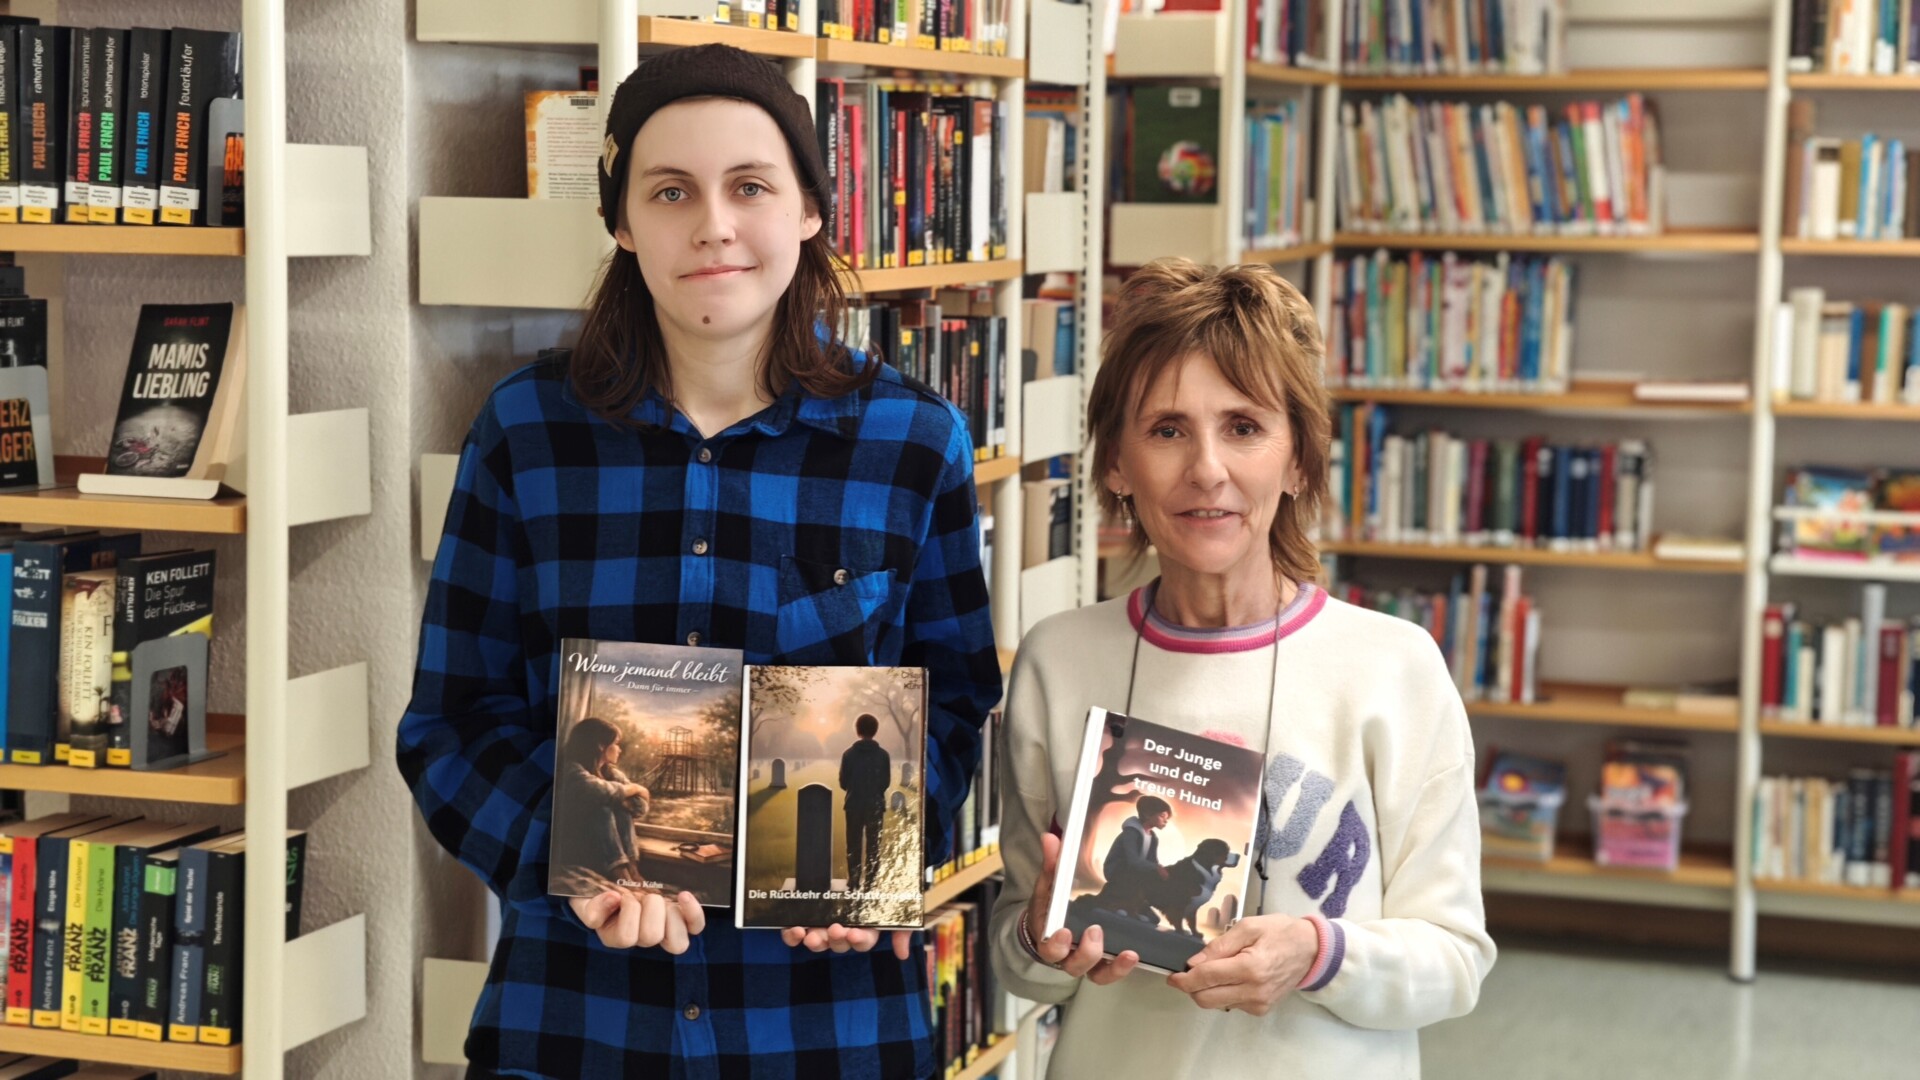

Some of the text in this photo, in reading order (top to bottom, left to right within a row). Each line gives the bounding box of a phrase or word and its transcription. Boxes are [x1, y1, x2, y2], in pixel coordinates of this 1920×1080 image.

[33, 38, 44, 93] rattenfänger
[80, 36, 90, 107] spurensammler
[104, 36, 116, 107] schattenschläfer
[140, 52, 151, 98] totenspieler
[179, 44, 193, 106] feuerläufer
[32, 102, 46, 169] PAUL FINCH
[78, 112, 92, 148] FINCH
[100, 112, 114, 148] FINCH
[136, 112, 150, 145] FINCH
[175, 112, 191, 148] FINCH
[77, 152, 90, 181] PAUL
[99, 152, 112, 181] PAUL
[135, 148, 148, 175] PAUL
[173, 152, 188, 182] PAUL
[148, 342, 210, 369] MAMIS
[132, 372, 211, 399] LIEBLING
[0, 399, 31, 428] ERZ
[146, 563, 210, 585] KEN FOLLETT
[126, 593, 135, 623] FOLLETT
[144, 600, 196, 619] der Füchse
[145, 585, 186, 602] Die Spur
[82, 626, 93, 701] KEN FOLLETT
[568, 652, 731, 684] Wenn jemand bleibt
[627, 682, 692, 694] Dann für immer
[1143, 738, 1223, 771] Der Junge
[1149, 762, 1210, 787] und der
[1133, 777, 1223, 811] treue Hund
[47, 870, 57, 912] Eisige Nähe
[184, 868, 194, 924] Spiel der Teufel
[749, 890, 768, 899] Die
[769, 889, 821, 900] Rückkehr
[823, 890, 842, 900] der
[213, 891, 224, 945] Teufelsbande
[13, 918, 29, 974] FRANZ
[44, 939, 55, 967] Franz
[69, 922, 83, 972] FRANZ
[91, 927, 106, 983] FRANZ
[121, 927, 137, 978] FRANZ
[178, 951, 189, 980] Franz
[43, 969, 54, 1010] Andreas
[177, 982, 187, 1023] Andreas
